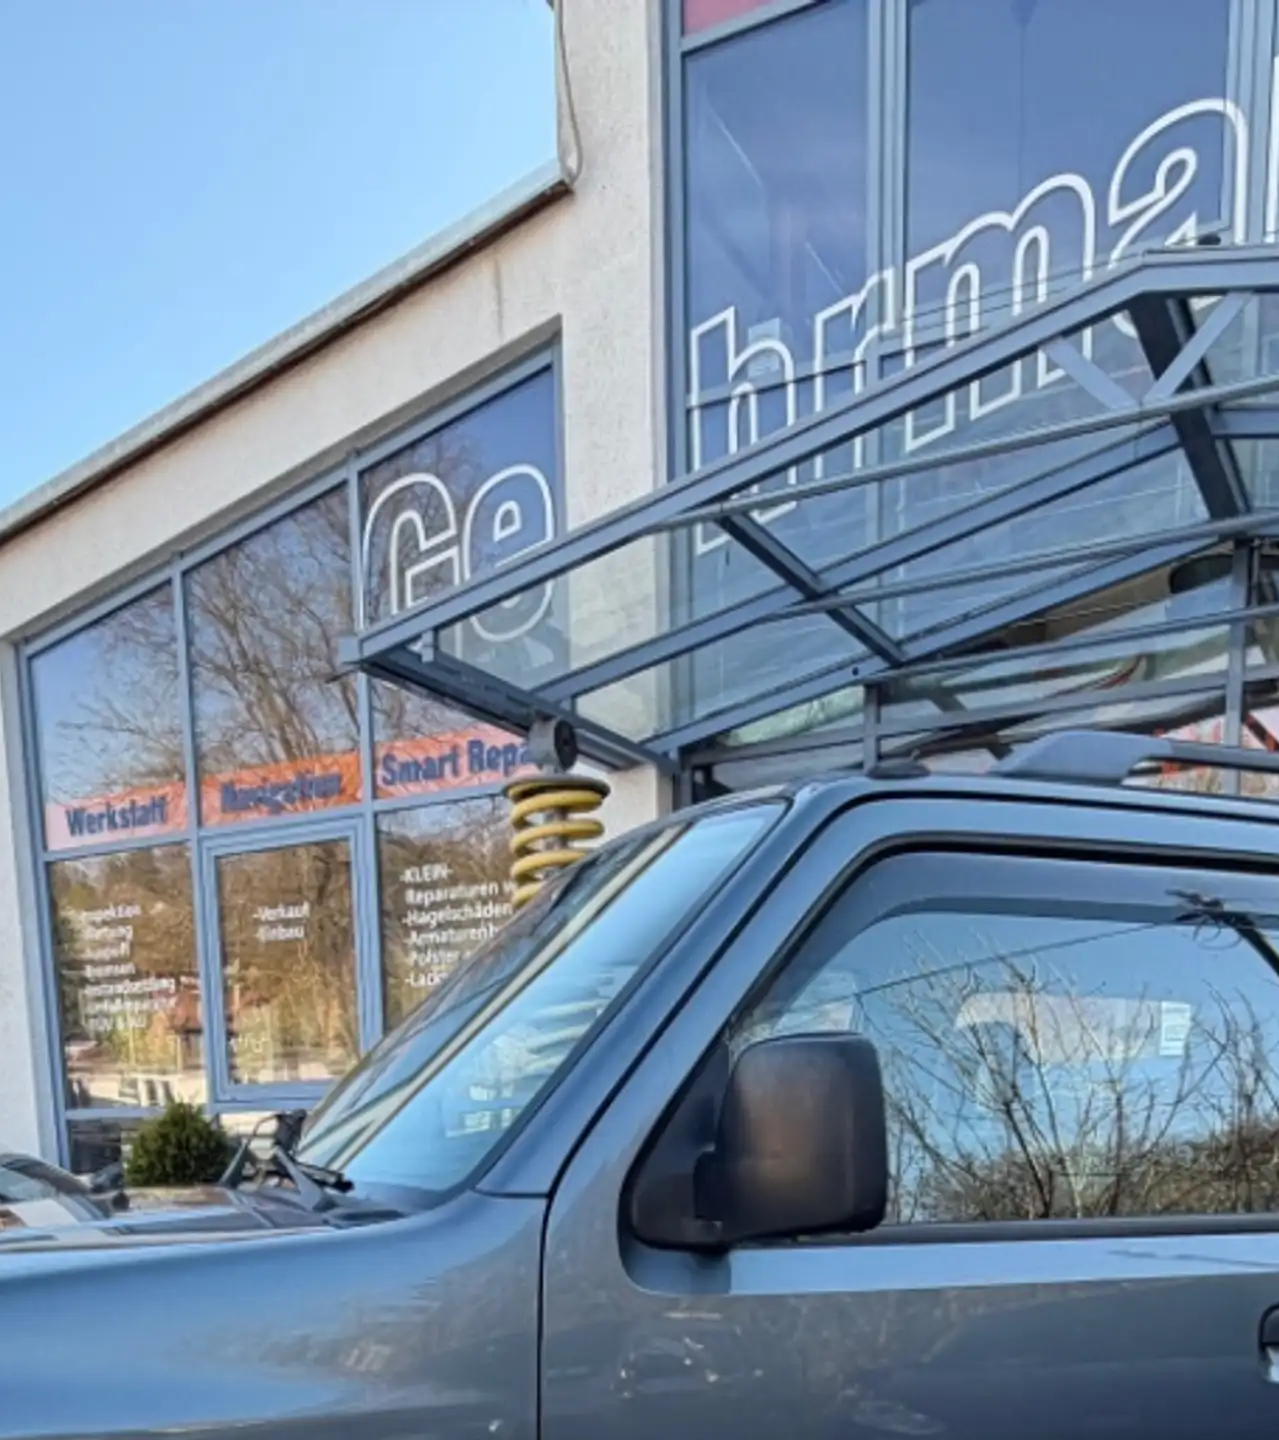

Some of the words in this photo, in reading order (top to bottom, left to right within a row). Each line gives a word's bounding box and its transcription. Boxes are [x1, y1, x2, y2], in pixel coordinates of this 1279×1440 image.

[382, 744, 459, 785] Smart
[467, 738, 536, 777] Repa
[65, 793, 167, 837] Werkstatt
